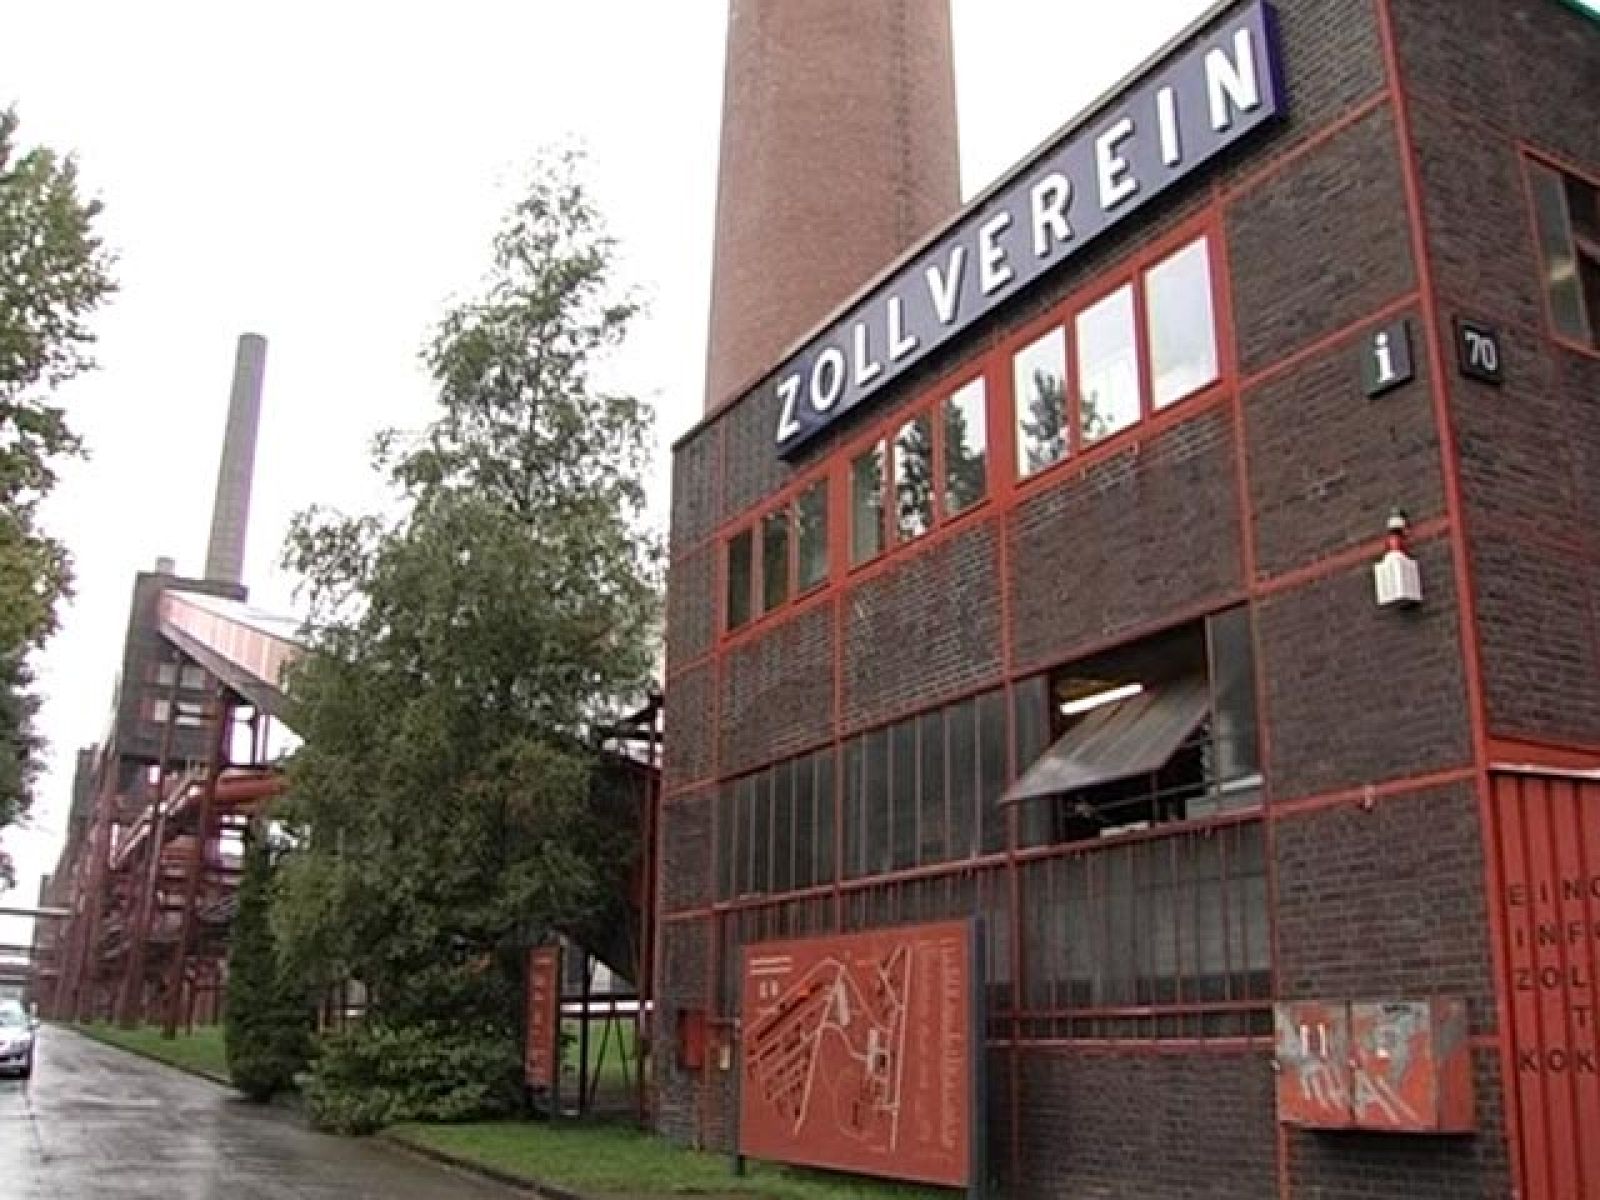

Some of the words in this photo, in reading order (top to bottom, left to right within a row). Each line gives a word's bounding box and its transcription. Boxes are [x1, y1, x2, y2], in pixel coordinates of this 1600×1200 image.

[776, 27, 1261, 444] ZOLLVEREIN
[1374, 331, 1395, 384] i
[1464, 329, 1497, 371] 70
[1516, 921, 1600, 948] INF
